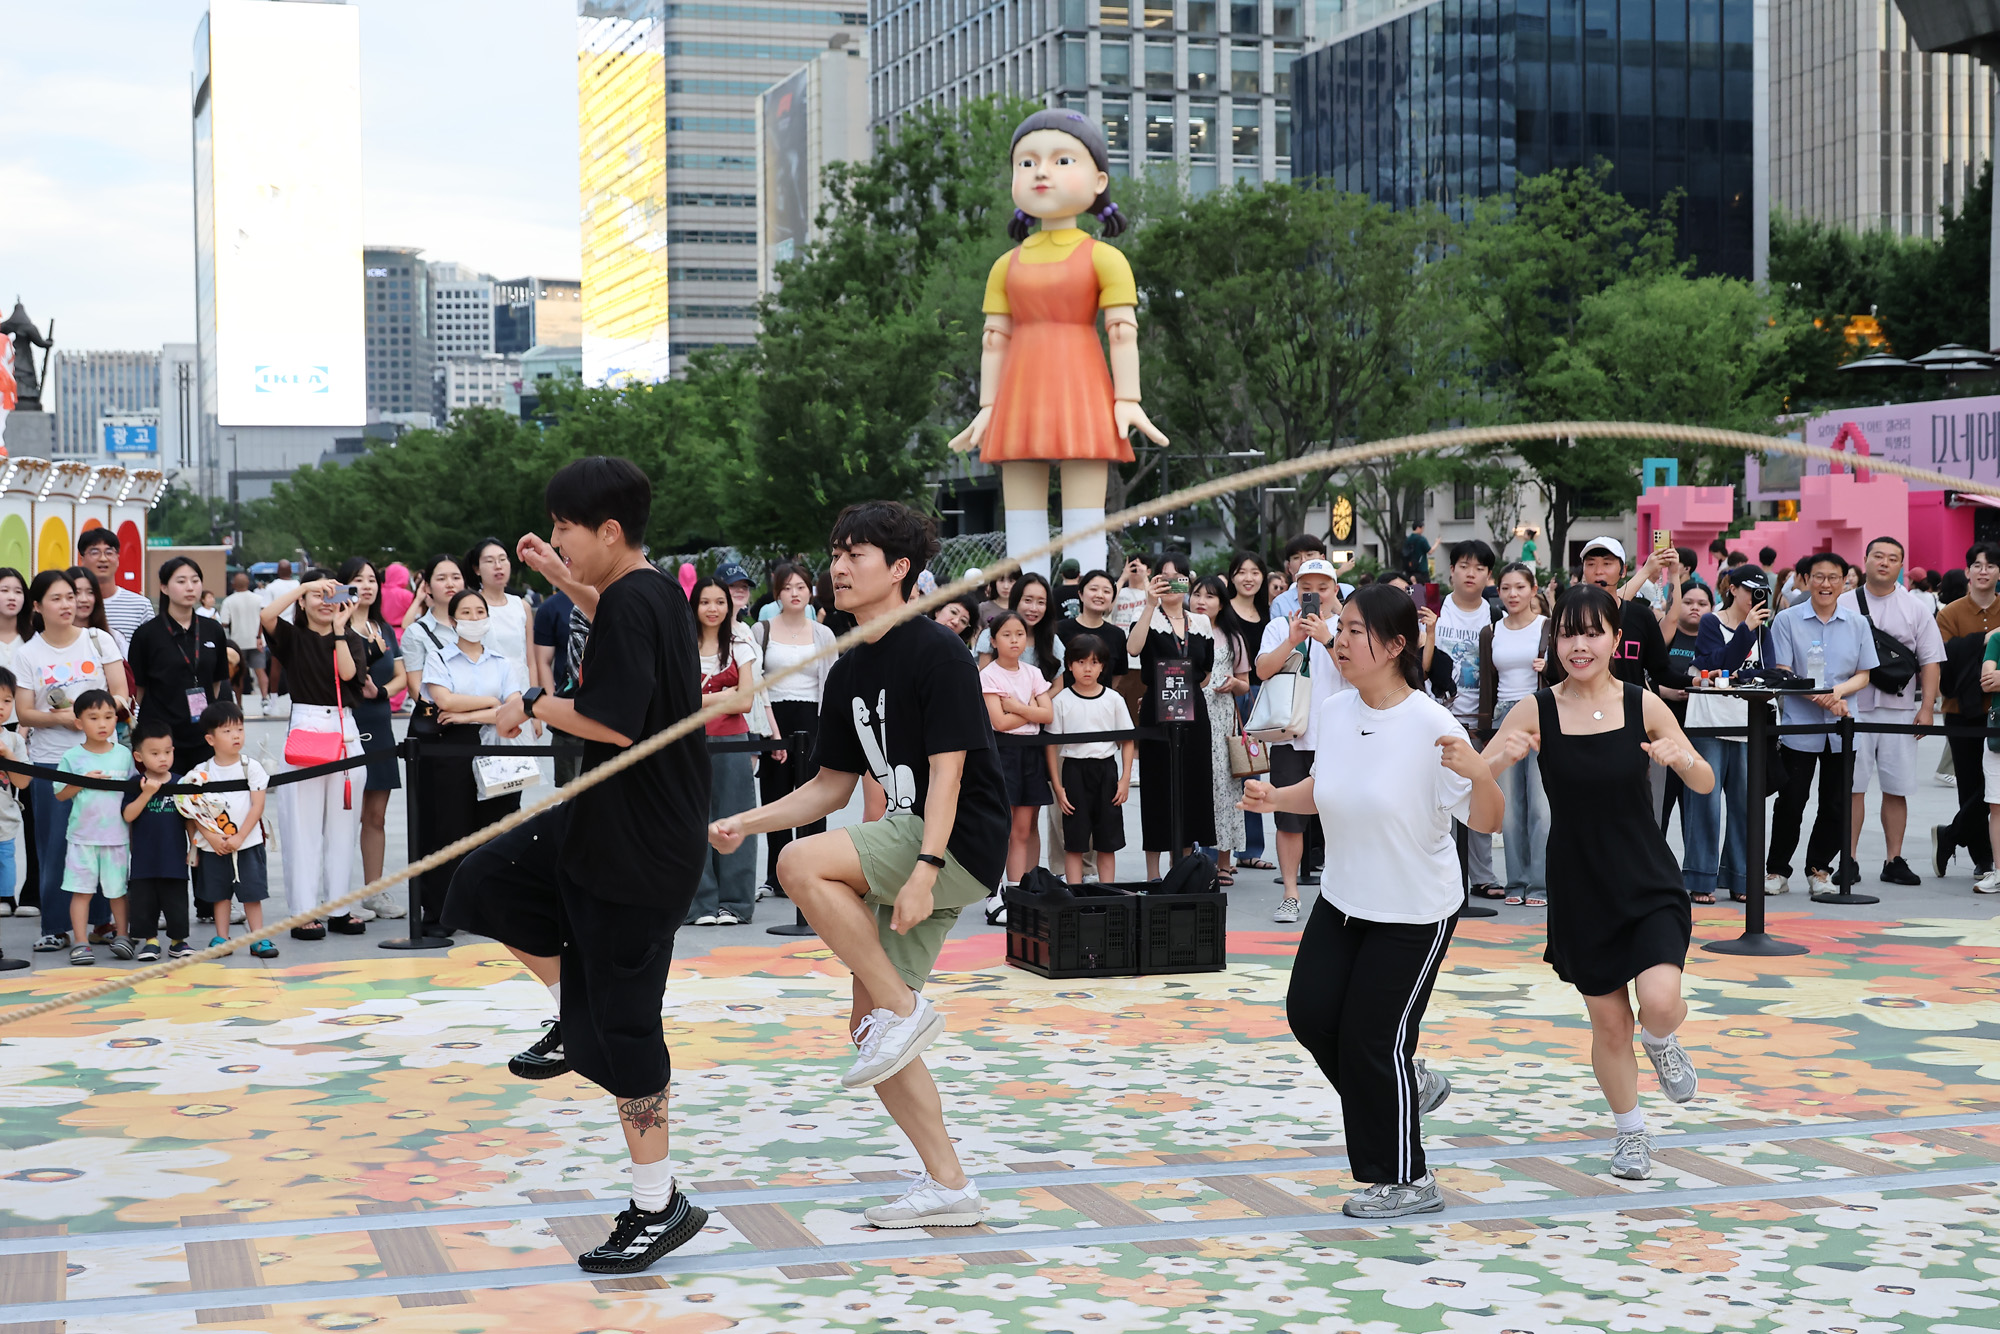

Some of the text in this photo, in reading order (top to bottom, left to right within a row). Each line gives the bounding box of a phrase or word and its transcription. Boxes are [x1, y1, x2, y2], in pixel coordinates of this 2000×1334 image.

[1438, 625, 1455, 638] THE
[1165, 676, 1185, 689] 출구
[1161, 689, 1189, 700] EXIT
